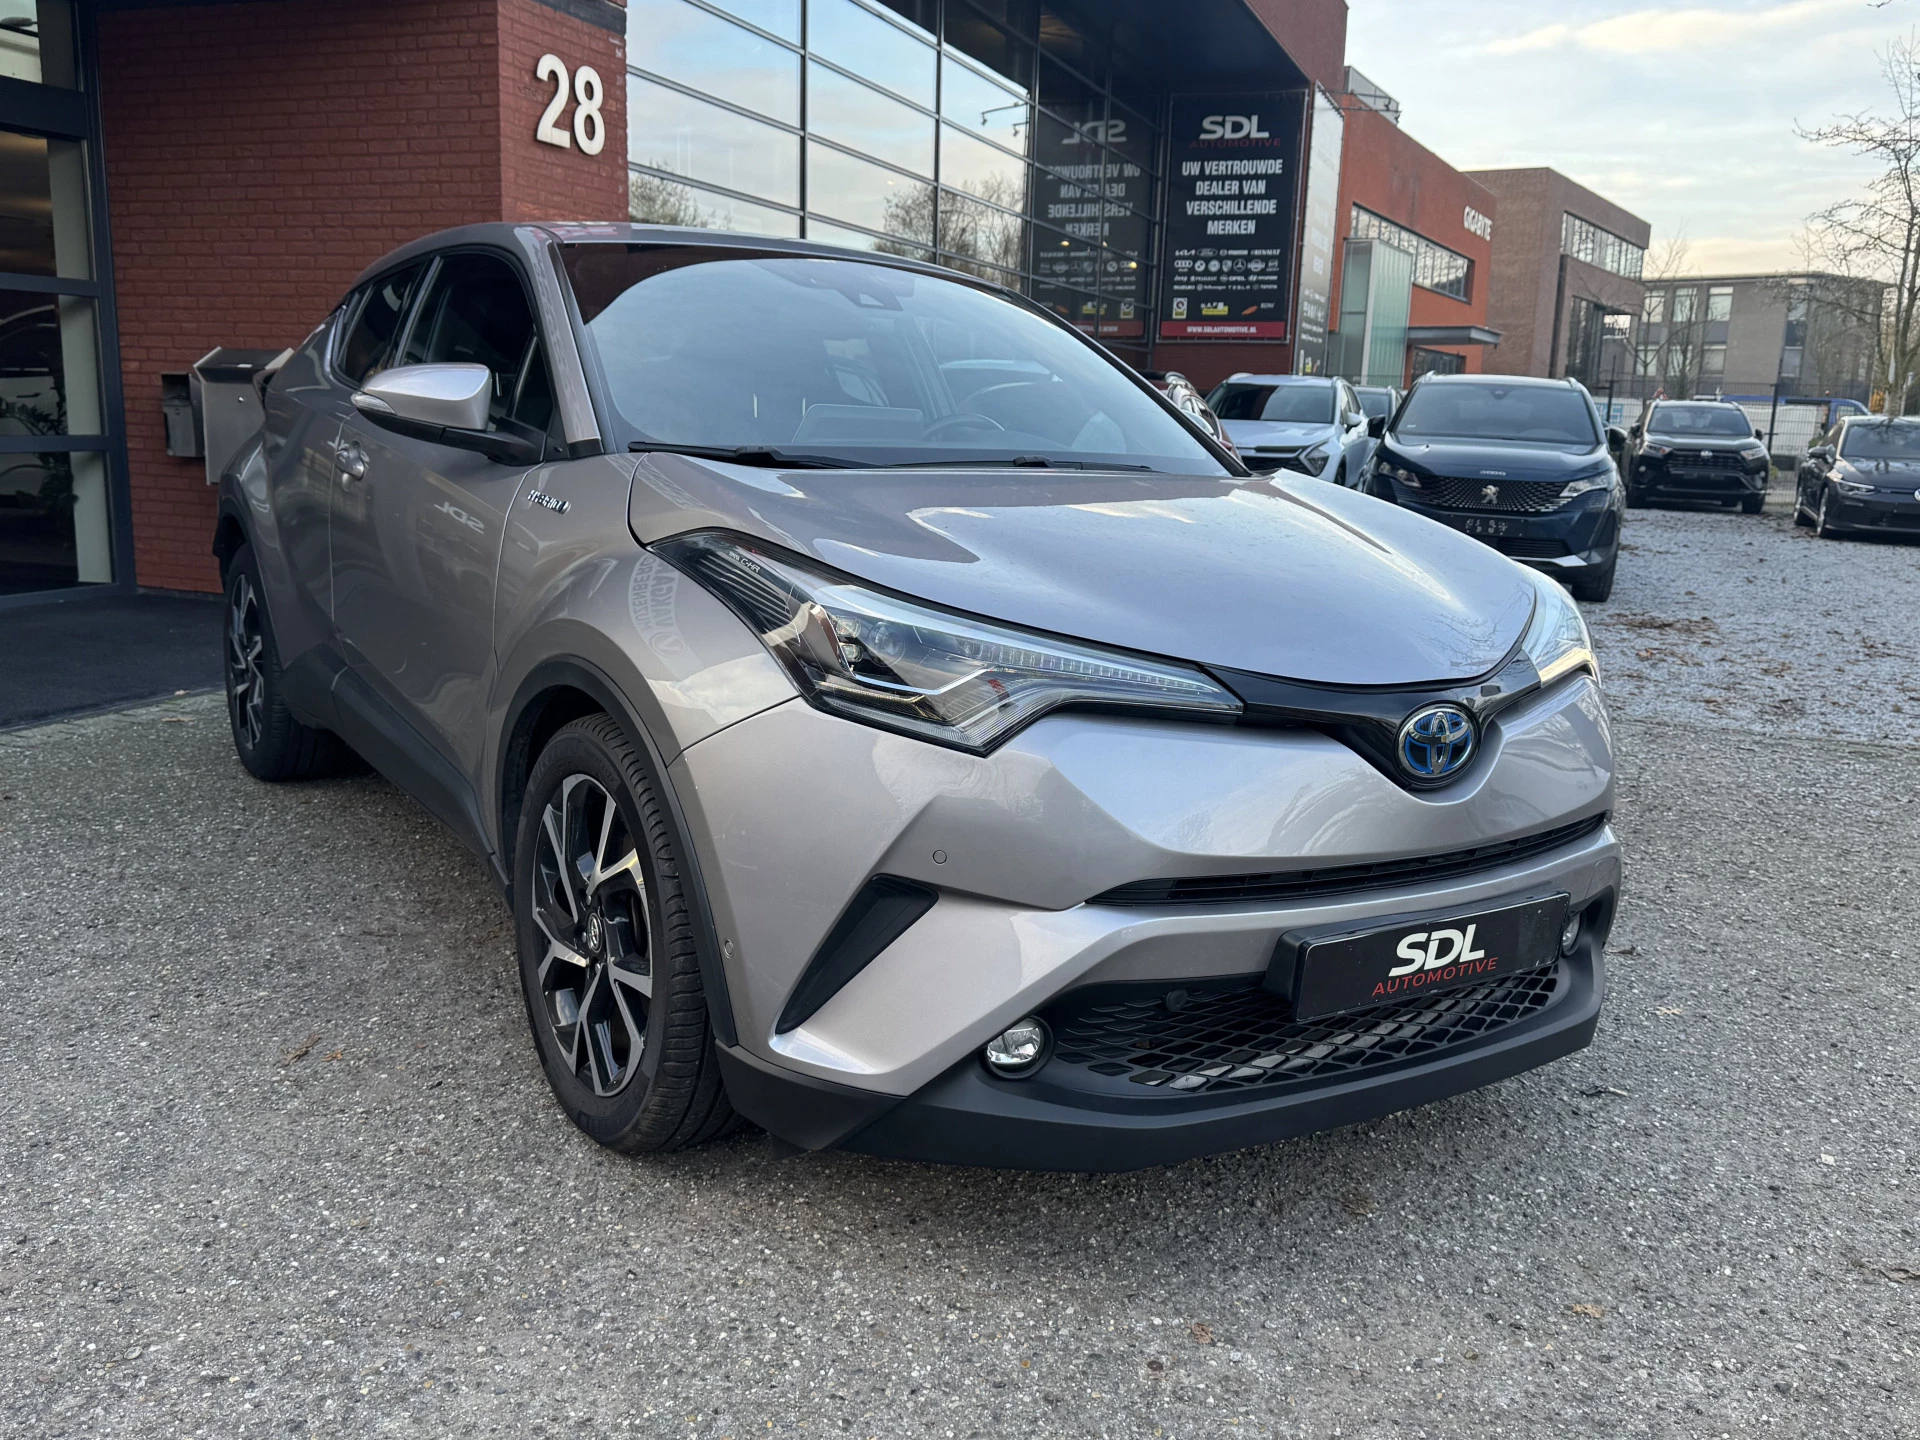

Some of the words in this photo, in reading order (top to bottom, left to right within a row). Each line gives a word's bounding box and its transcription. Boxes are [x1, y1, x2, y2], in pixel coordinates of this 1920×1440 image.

[536, 53, 606, 156] 28
[1199, 115, 1270, 139] SDL
[1189, 138, 1281, 149] AUTOMOTIVE
[1182, 161, 1201, 176] UW
[1203, 159, 1283, 175] VERTROUWDE
[1195, 180, 1240, 195] DEALER
[1242, 180, 1266, 194] VAN
[1186, 199, 1277, 215] VERSCHILLENDE
[1207, 219, 1256, 235] MERKEN
[740, 558, 761, 573] C-HR
[1388, 923, 1485, 977] SDL
[1371, 957, 1498, 997] AUTOMOTIVE
